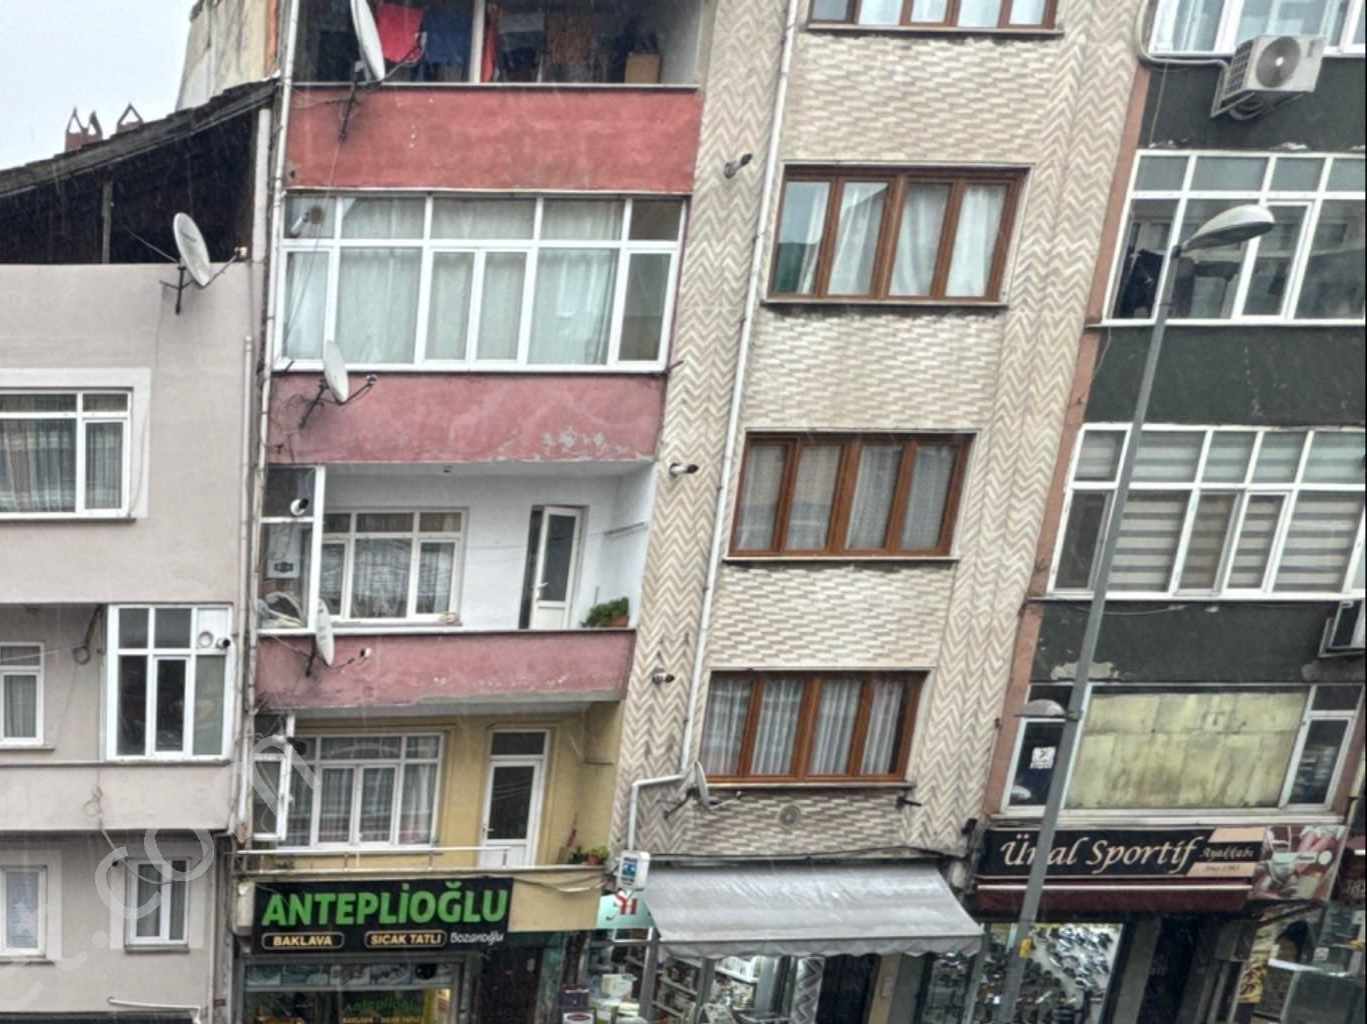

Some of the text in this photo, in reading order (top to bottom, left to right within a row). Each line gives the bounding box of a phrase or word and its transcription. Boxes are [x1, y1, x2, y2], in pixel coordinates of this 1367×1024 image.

[1085, 835, 1204, 874] Sportif
[261, 880, 509, 926] ANTEPLİOĞLU
[272, 935, 333, 947] BAKLAVA
[369, 933, 442, 946] SICAK TATLI
